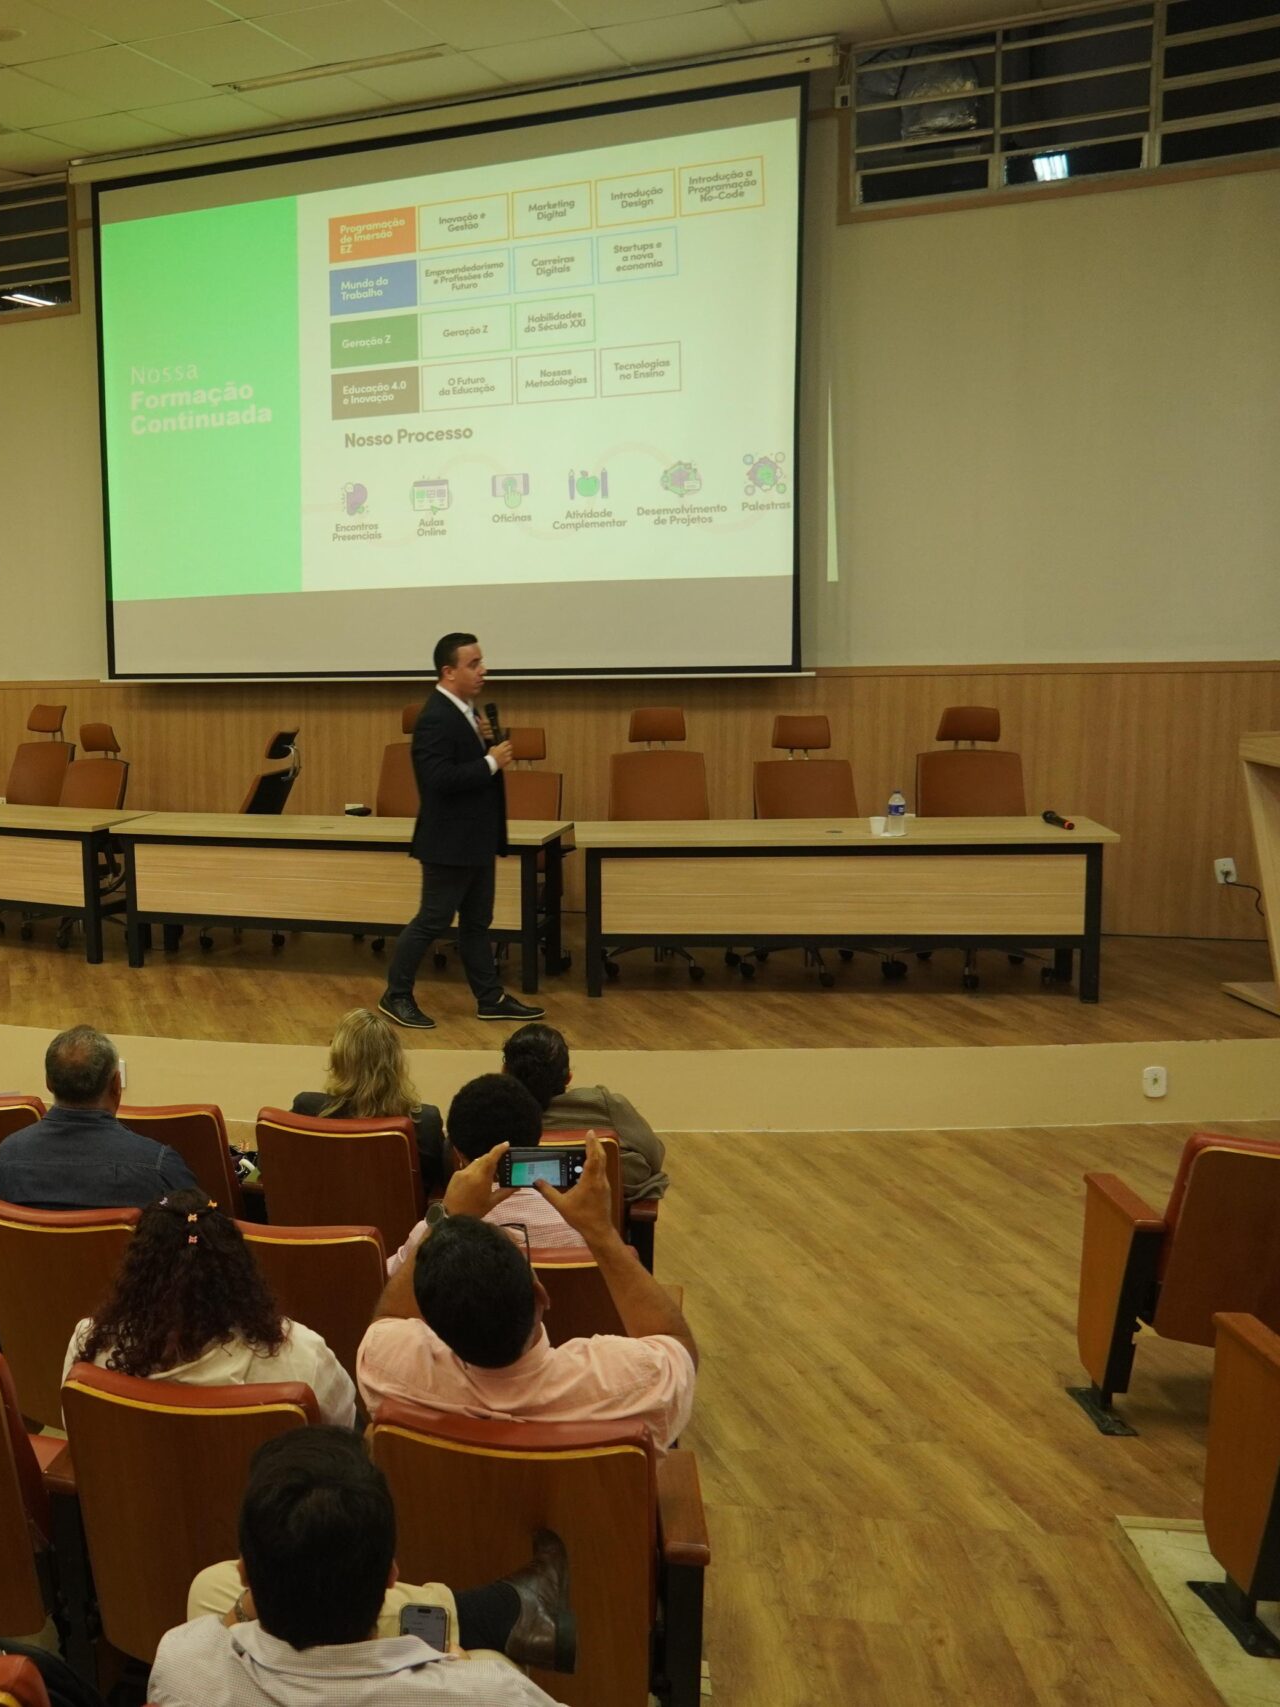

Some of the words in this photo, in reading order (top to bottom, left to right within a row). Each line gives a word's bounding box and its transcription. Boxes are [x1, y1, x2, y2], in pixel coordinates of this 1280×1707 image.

[688, 178, 756, 195] Programação
[611, 186, 663, 201] Introdução
[529, 200, 575, 212] Marketing
[621, 198, 653, 208] Design
[439, 214, 478, 225] Inovação
[537, 209, 566, 220] Digital
[448, 221, 479, 232] Gestão
[354, 230, 392, 242] Imersão
[614, 242, 653, 254] Startups
[532, 255, 575, 267] Carreiras
[630, 252, 653, 260] nova
[425, 261, 503, 279] Empreendedorismo
[536, 264, 570, 276] Digitais
[616, 259, 663, 272] economia
[341, 279, 374, 291] Mundo
[440, 273, 479, 285] Profissões
[452, 282, 477, 291] Futuro
[341, 289, 382, 301] Trabalho
[528, 311, 582, 324] Habilidades
[538, 320, 567, 332] Século
[570, 318, 586, 328] XXI
[443, 327, 480, 338] Geração
[482, 325, 488, 333] Z
[342, 336, 383, 349] Geração
[385, 335, 391, 344] Z
[614, 359, 670, 371] Tecnologias
[131, 364, 198, 385] Nossa
[540, 368, 572, 378] Nossas
[634, 369, 664, 379] Ensino
[448, 378, 455, 386] O
[457, 376, 485, 385] Futuro
[525, 376, 587, 388] Metodologias
[343, 383, 389, 396] Educação
[391, 382, 406, 391] 4.0
[453, 383, 495, 395] Educação
[131, 381, 253, 410] Formação
[351, 393, 394, 405] Inovação
[131, 405, 272, 435] Continuada
[345, 433, 392, 448] Nosso
[397, 427, 473, 444] Processo
[637, 503, 727, 516] Desenvolvimento
[742, 501, 791, 511] Palestras
[492, 513, 531, 523] Oficinas
[565, 509, 612, 519] Atividade
[335, 522, 378, 532] Encontros
[419, 518, 444, 527] Aulas
[553, 519, 627, 531] Complementar
[654, 516, 666, 525] de
[669, 515, 713, 527] Projetos
[332, 531, 382, 542] Presenciais
[417, 527, 446, 536] Online
